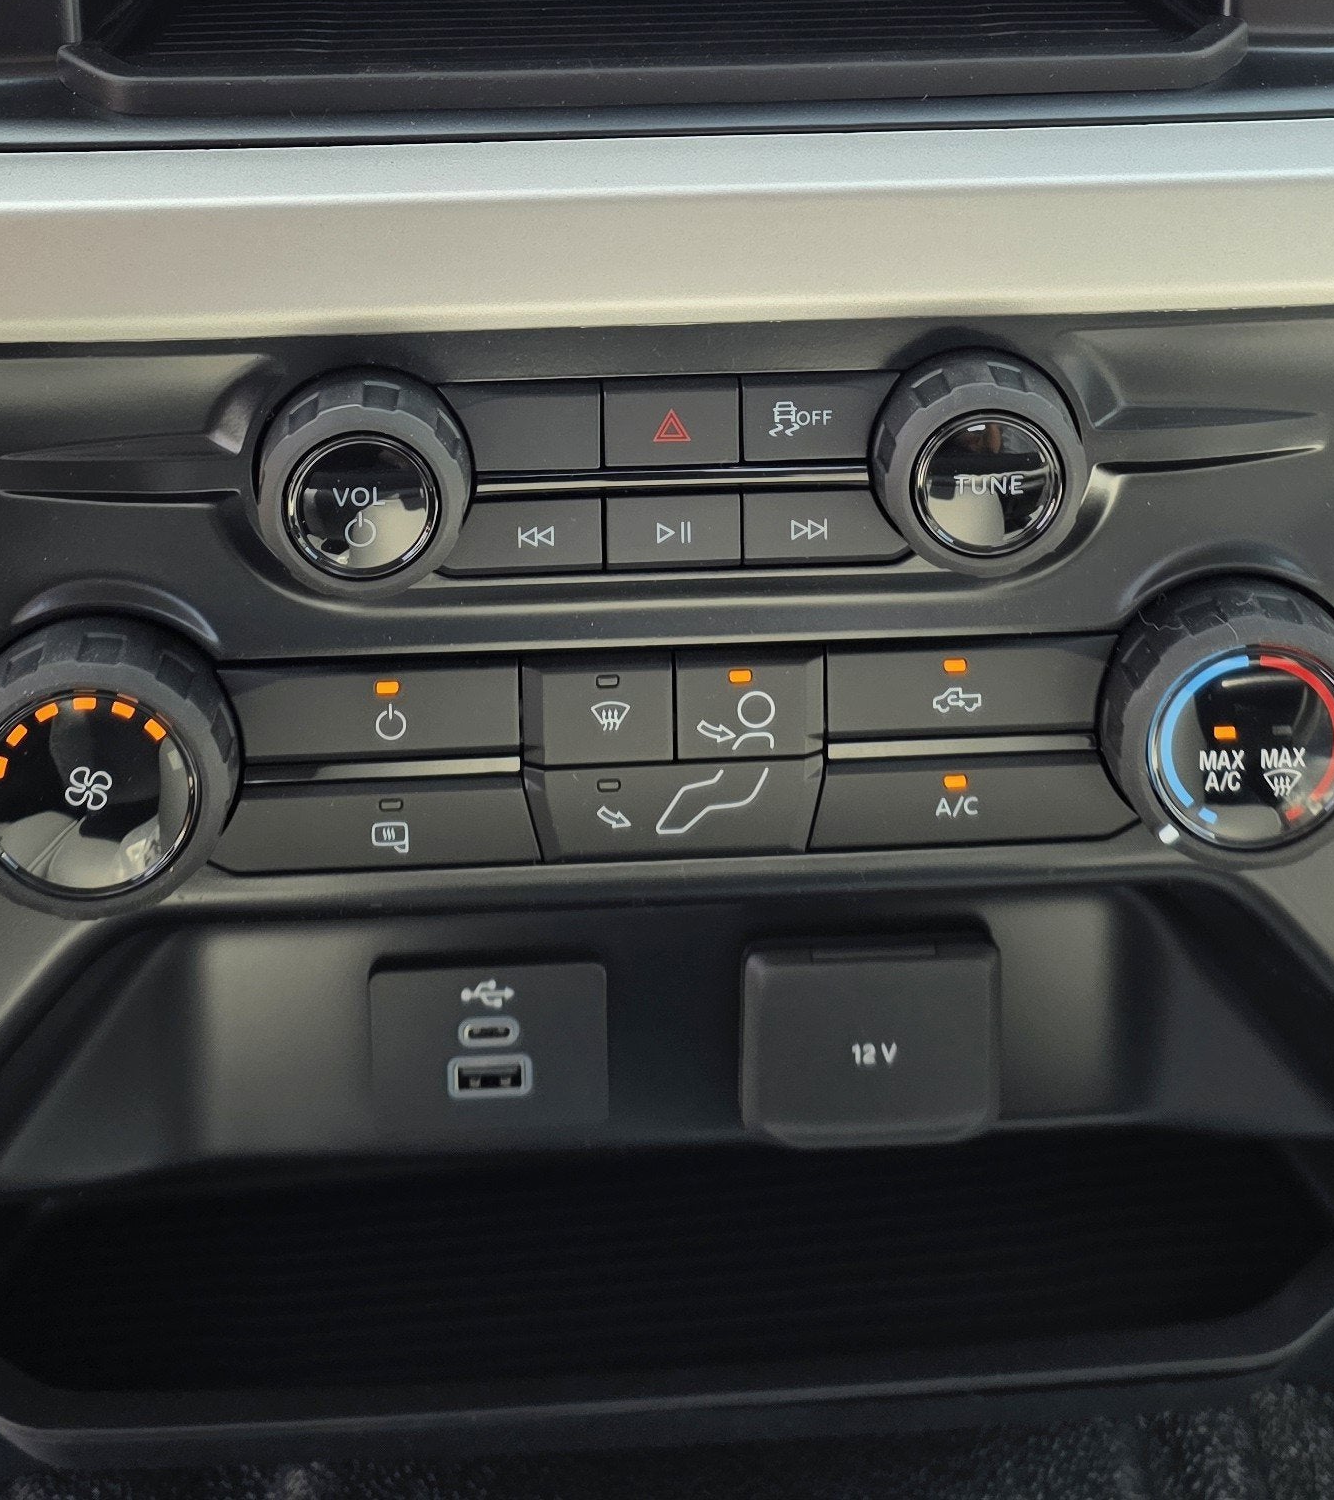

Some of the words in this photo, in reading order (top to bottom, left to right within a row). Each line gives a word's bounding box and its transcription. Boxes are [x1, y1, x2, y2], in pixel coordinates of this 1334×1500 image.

[796, 409, 833, 426] OFF
[953, 474, 1024, 495] TUNE
[332, 486, 385, 507] VOL
[1199, 749, 1245, 771] MAX
[1260, 746, 1306, 769] MAX
[1204, 771, 1241, 792] A/C
[935, 796, 979, 817] A/C
[851, 1042, 876, 1065] 12
[880, 1041, 898, 1065] V
